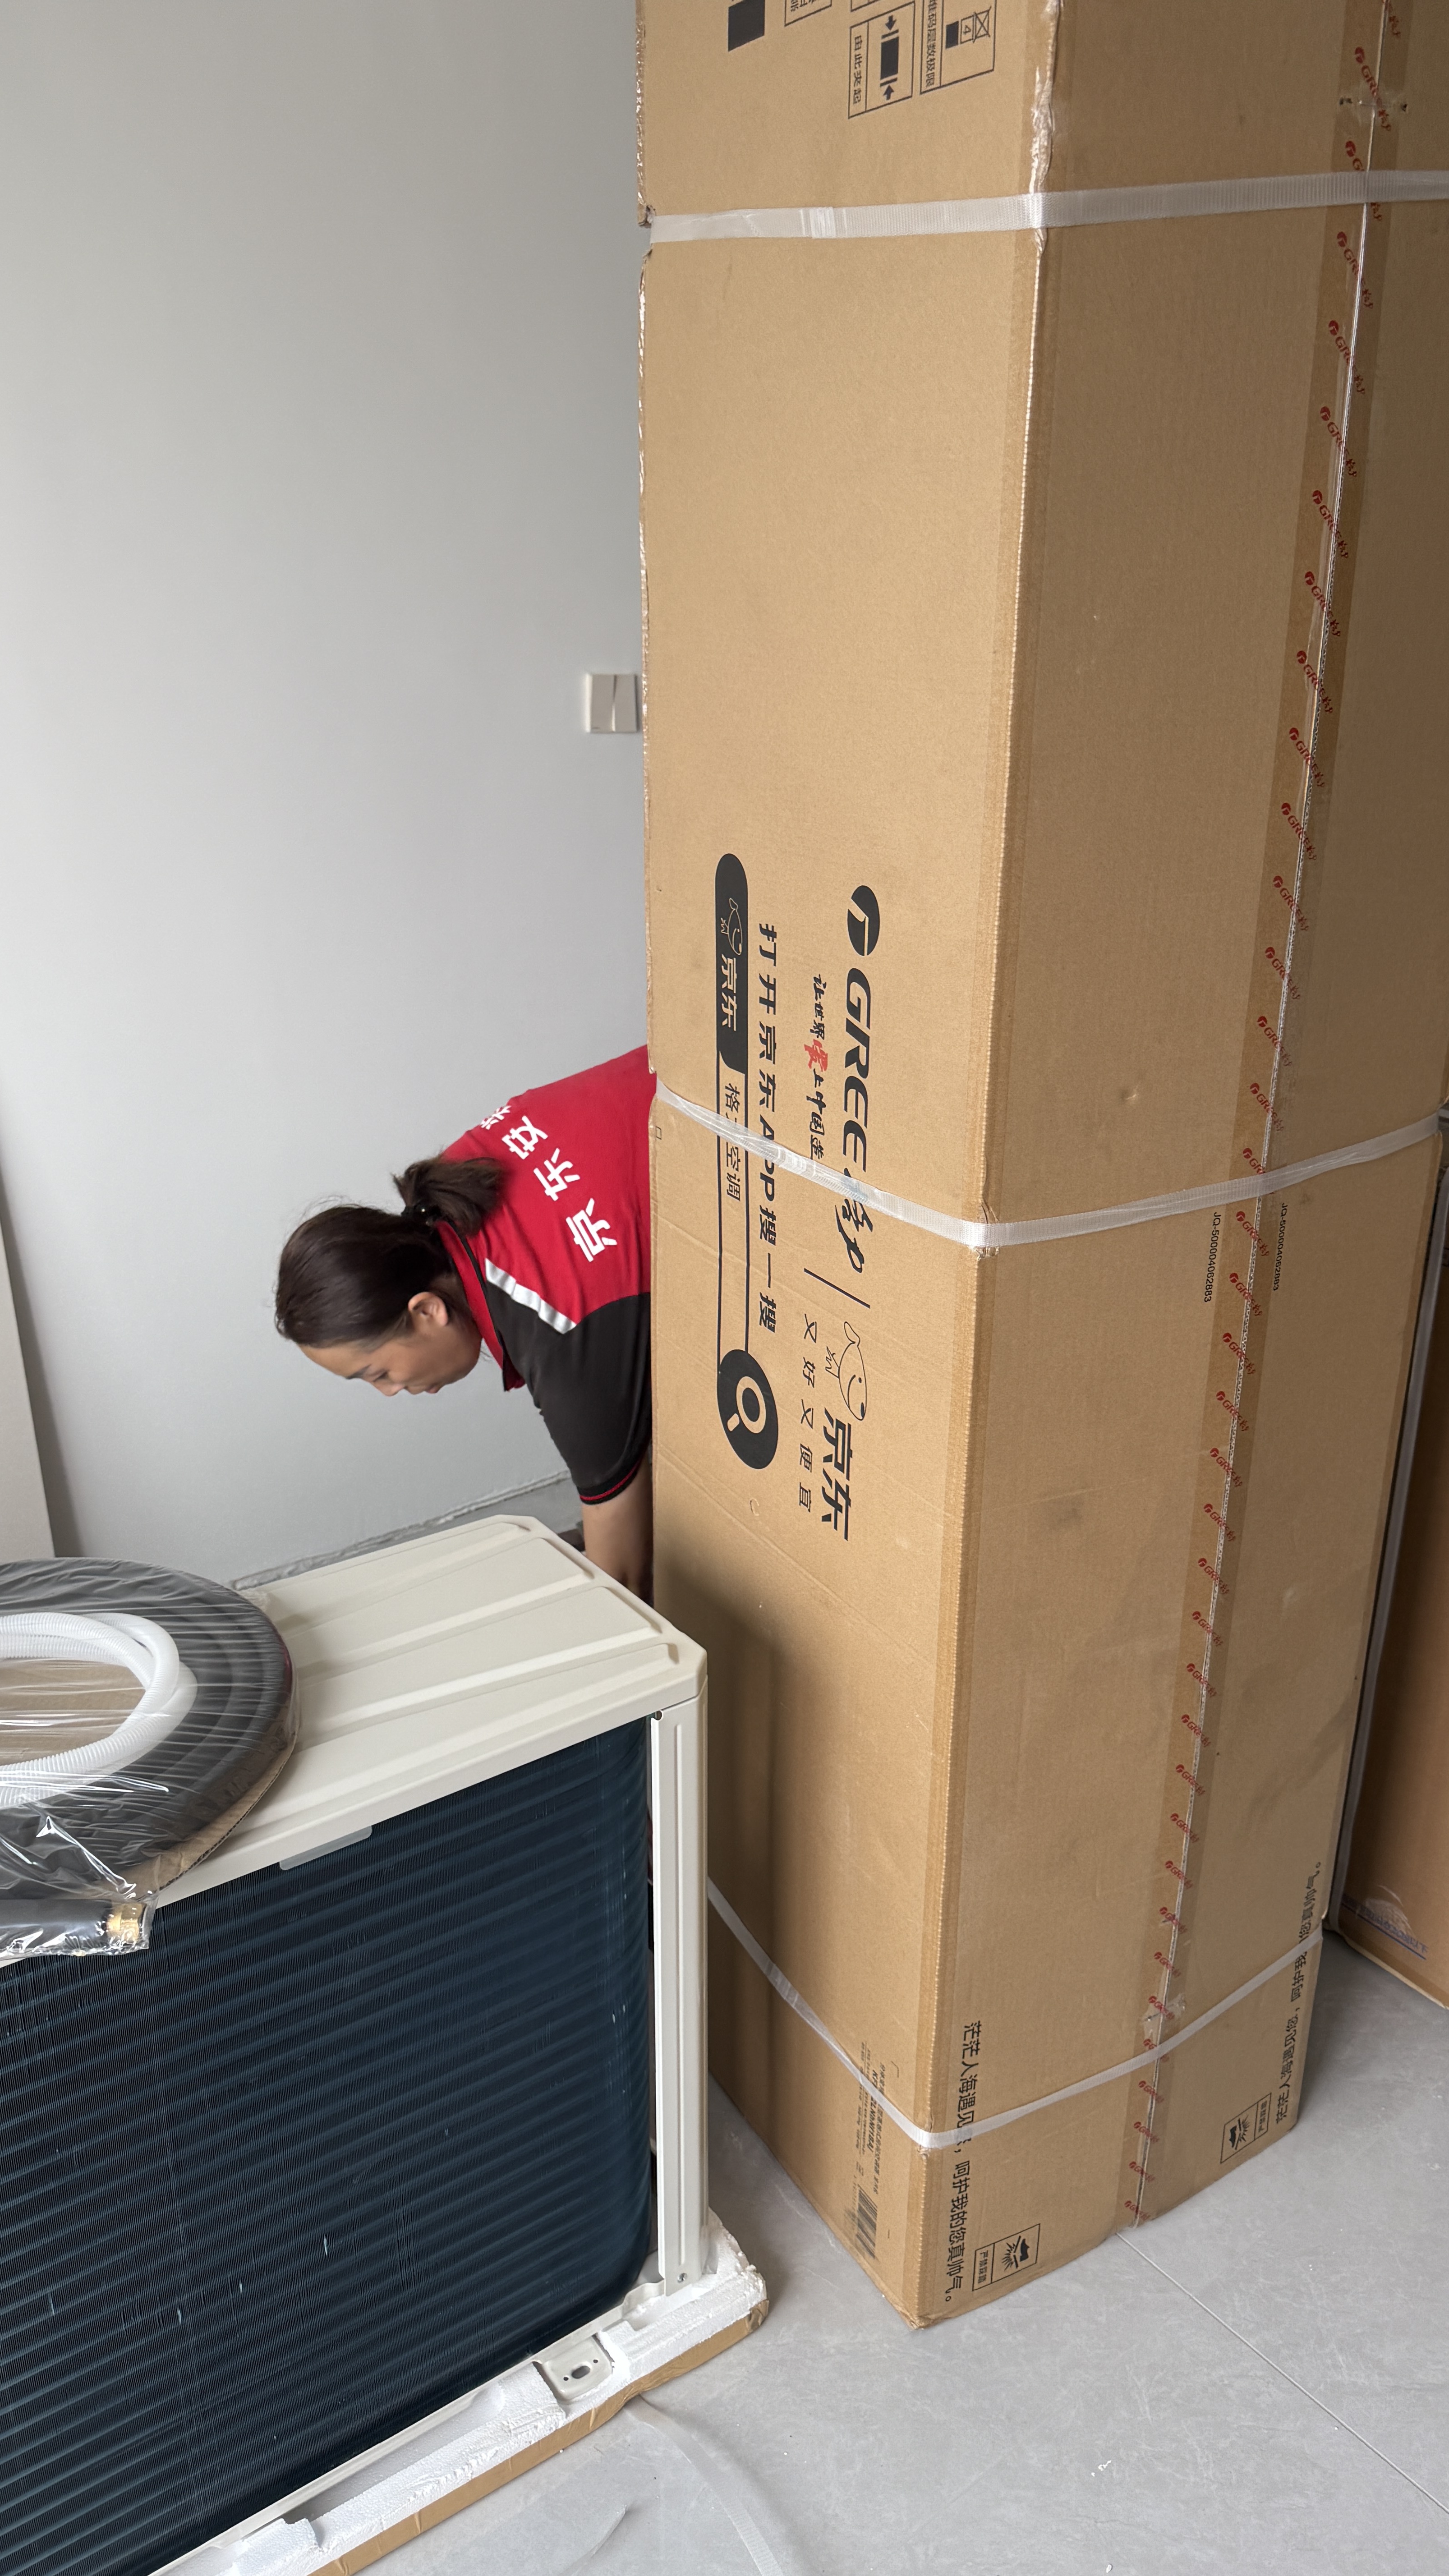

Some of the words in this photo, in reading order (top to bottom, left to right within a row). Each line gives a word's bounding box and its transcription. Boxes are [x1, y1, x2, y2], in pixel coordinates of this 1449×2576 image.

[853, 35, 863, 105] 由此夹起
[962, 25, 971, 36] 4
[721, 953, 737, 1031] 京东
[724, 1083, 741, 1201] 格空调
[1204, 1212, 1221, 1302] JQ-500004062883
[799, 1313, 818, 1513] 又好又便宜
[821, 1408, 853, 1541] 京东
[1276, 1861, 1321, 2124] 茫茫人海遇见您，呵护我您真帅气。
